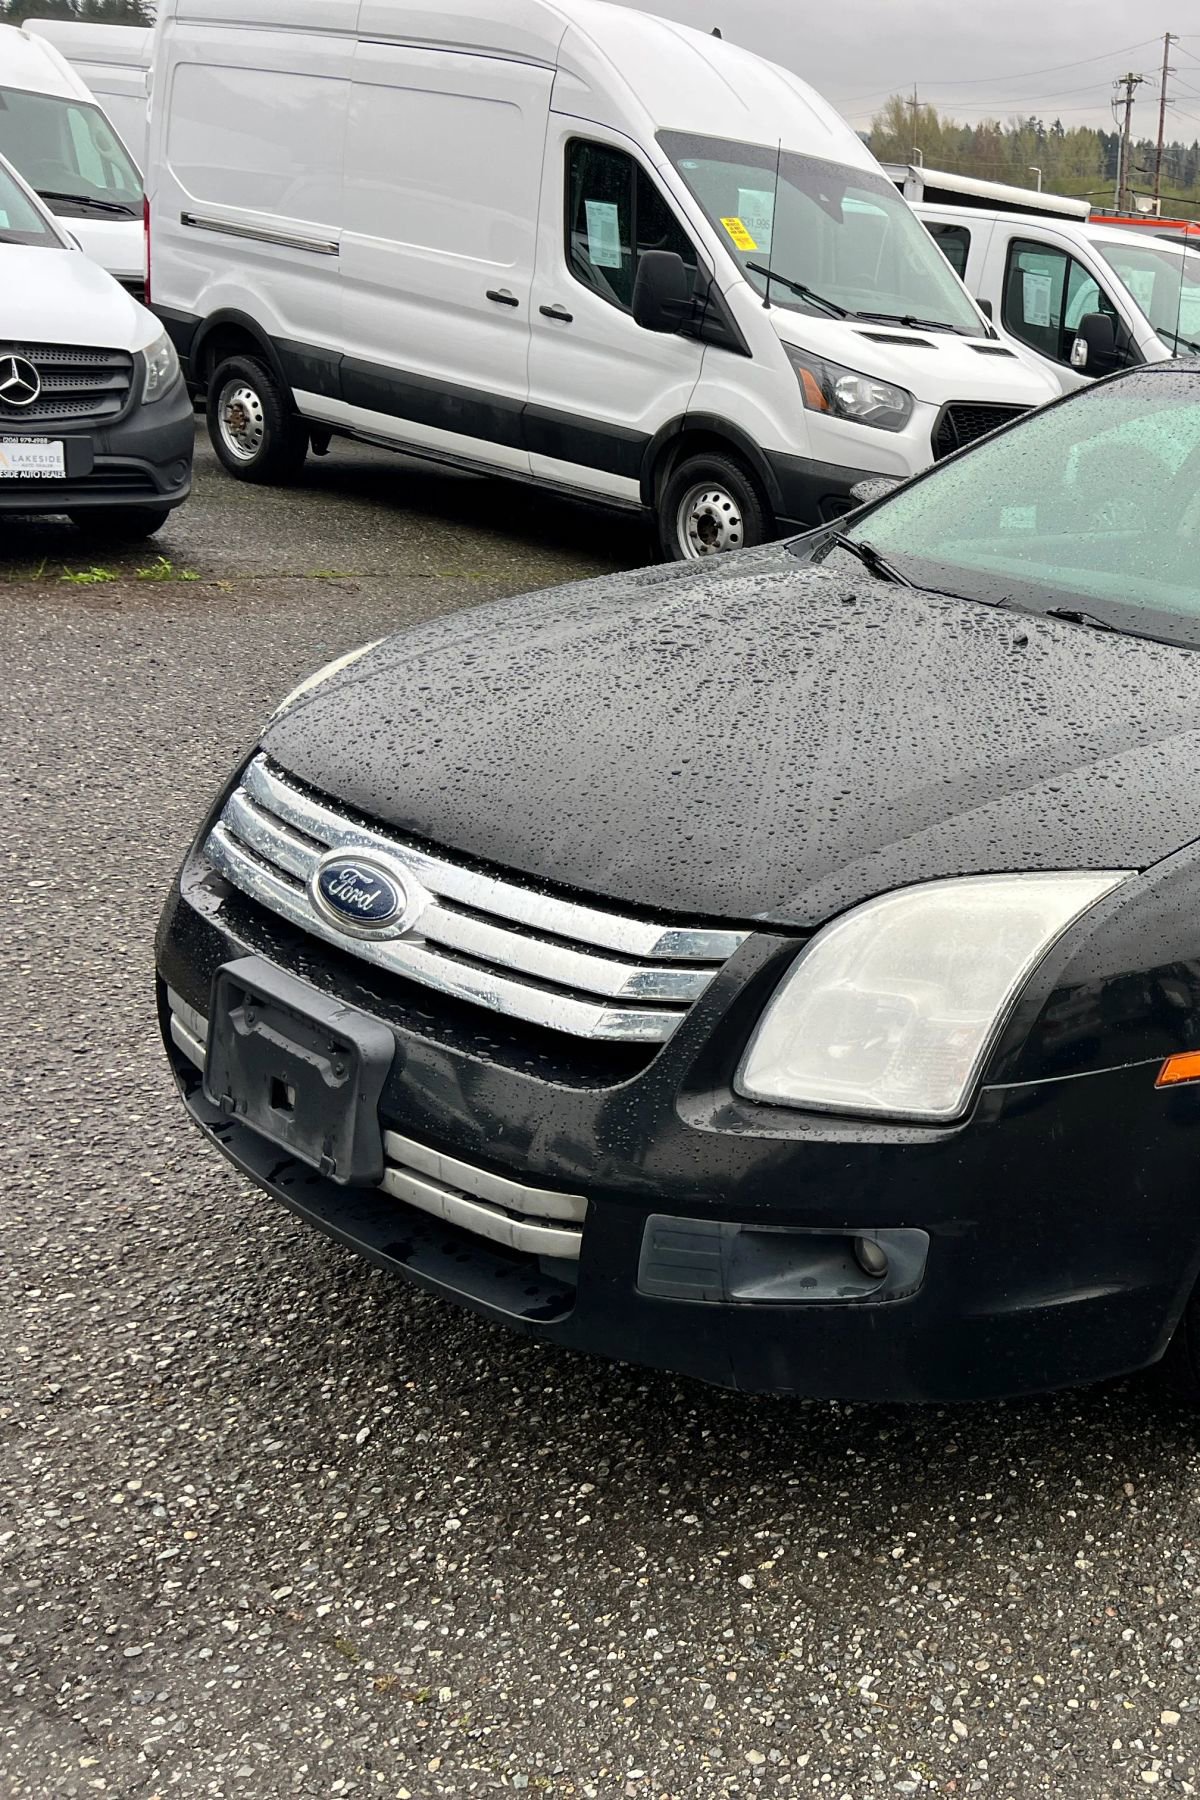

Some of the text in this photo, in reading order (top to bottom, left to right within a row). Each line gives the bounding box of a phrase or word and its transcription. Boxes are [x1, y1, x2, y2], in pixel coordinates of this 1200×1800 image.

[11, 455, 62, 463] LAKESIDE
[20, 470, 40, 478] AUTO
[41, 470, 66, 479] DEALER
[328, 868, 382, 911] Ford
